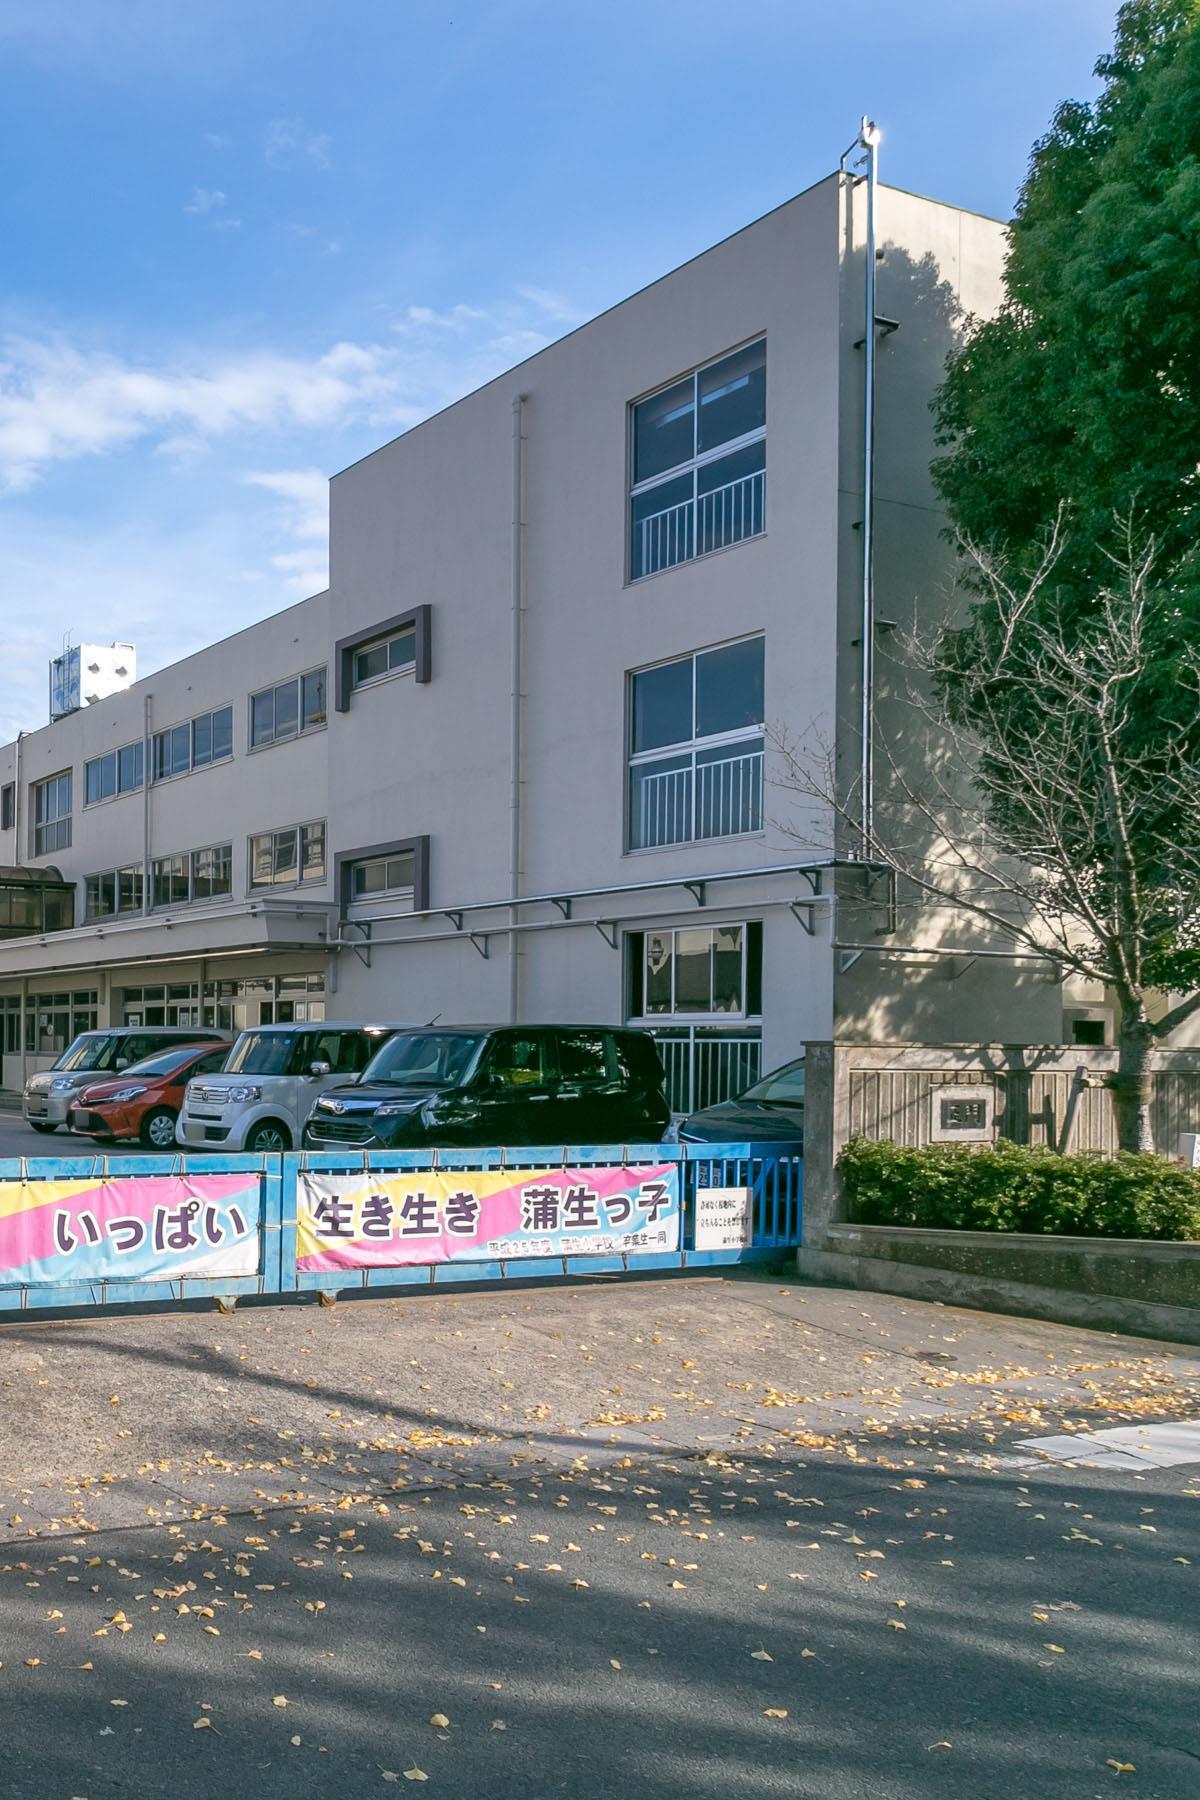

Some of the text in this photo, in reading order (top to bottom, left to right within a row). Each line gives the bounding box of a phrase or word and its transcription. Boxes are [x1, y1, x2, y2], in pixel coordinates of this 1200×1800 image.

[54, 1197, 248, 1256] いっぱい
[313, 1182, 671, 1240] 生き生き 蒲生っ子
[488, 1240, 553, 1256] 平成25年度
[623, 1231, 667, 1247] 卒業生一同
